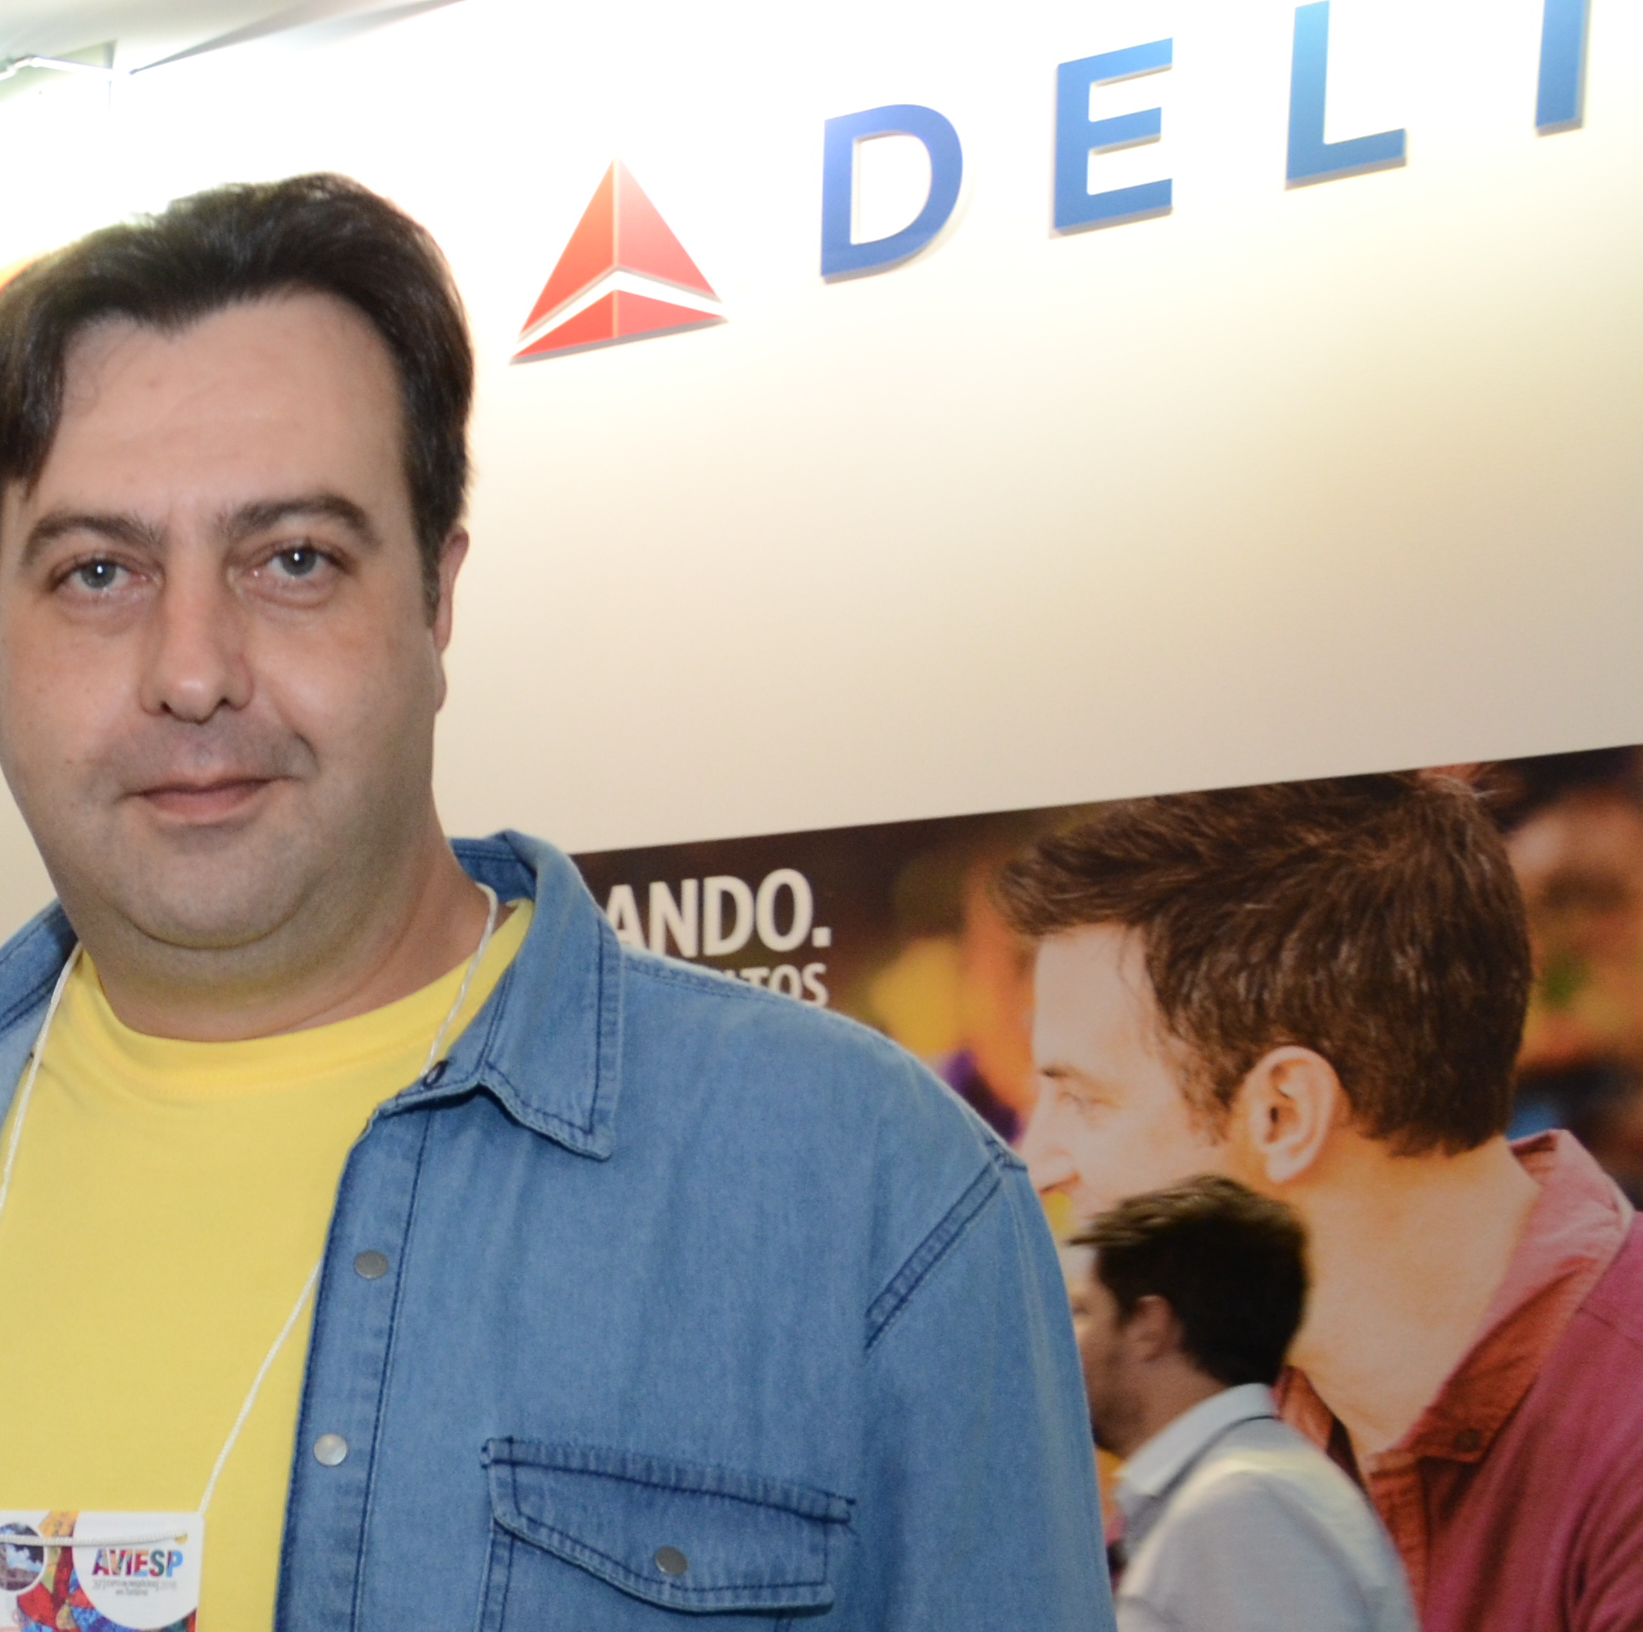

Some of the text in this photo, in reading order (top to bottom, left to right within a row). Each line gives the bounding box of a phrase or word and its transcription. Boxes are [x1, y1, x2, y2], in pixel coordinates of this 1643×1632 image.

[605, 868, 832, 958] ANDO.
[723, 962, 830, 1007] TOS
[92, 1549, 184, 1578] AVIESP
